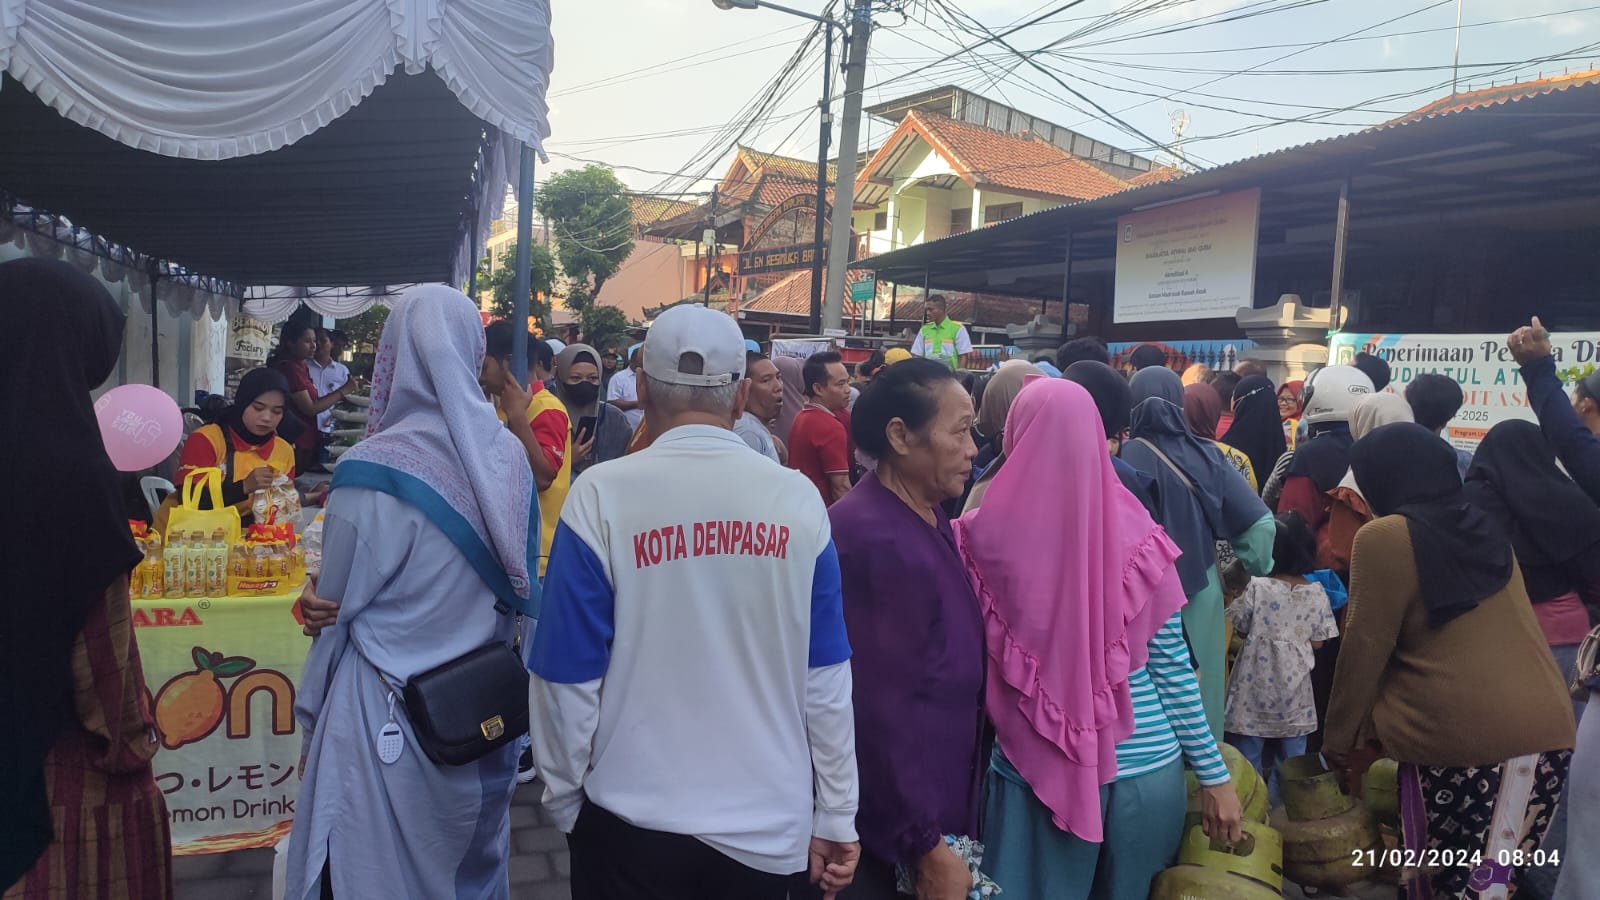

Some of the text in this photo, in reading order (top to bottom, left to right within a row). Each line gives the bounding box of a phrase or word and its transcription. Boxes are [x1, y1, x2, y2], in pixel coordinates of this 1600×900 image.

[802, 247, 827, 262] BAT
[1362, 342, 1474, 364] Penerimaan
[1453, 410, 1489, 422] -2025
[633, 520, 790, 569] KOTA DENPASAR
[132, 606, 204, 627] ARA
[233, 794, 295, 818] Drink
